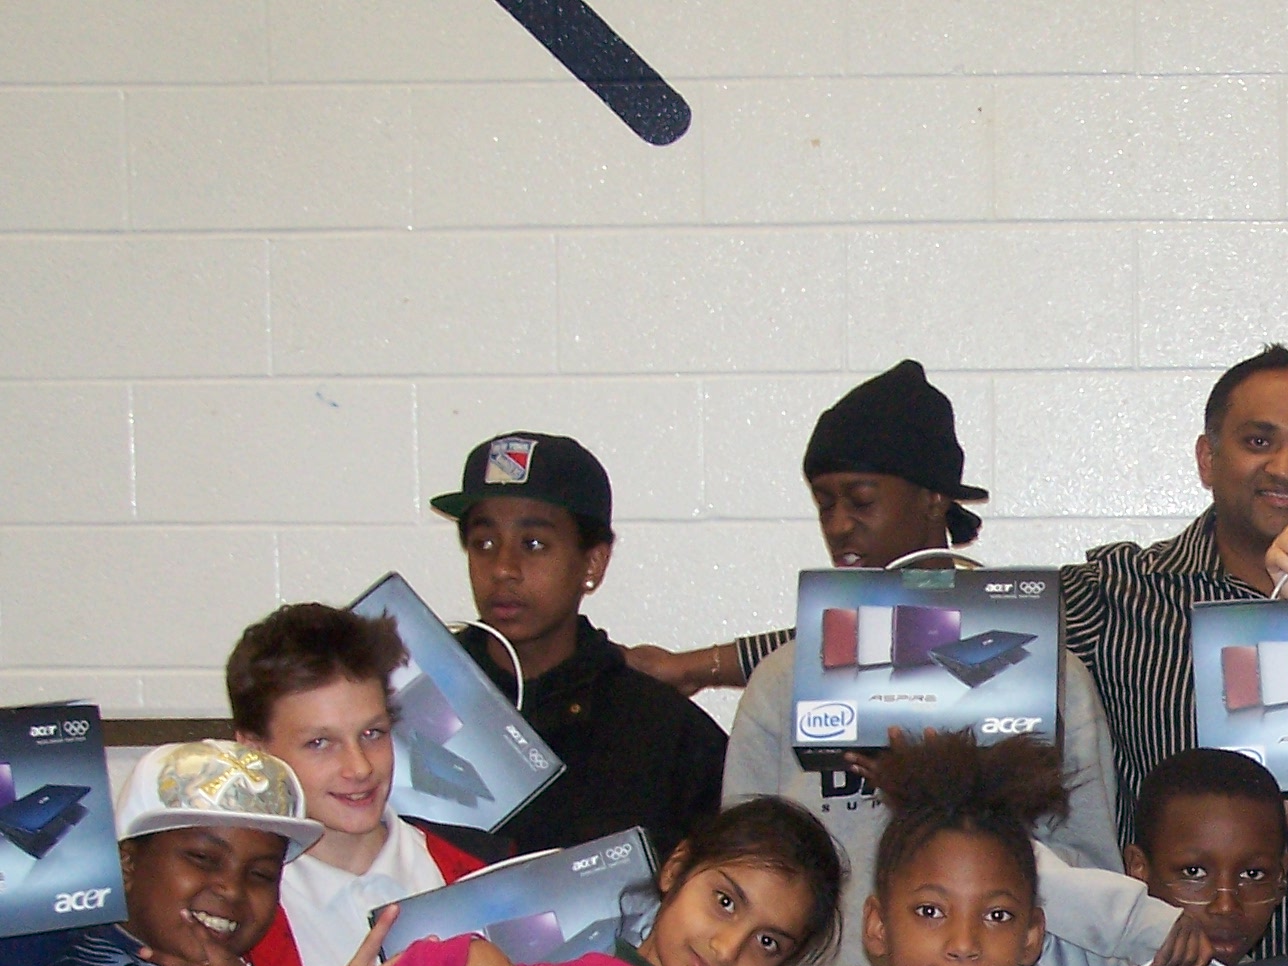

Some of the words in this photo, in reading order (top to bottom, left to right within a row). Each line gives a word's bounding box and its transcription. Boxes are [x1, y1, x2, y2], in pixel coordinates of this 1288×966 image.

[869, 694, 937, 703] ASPIRE
[808, 711, 846, 728] intel
[982, 717, 1042, 734] acer
[55, 887, 112, 913] acer
